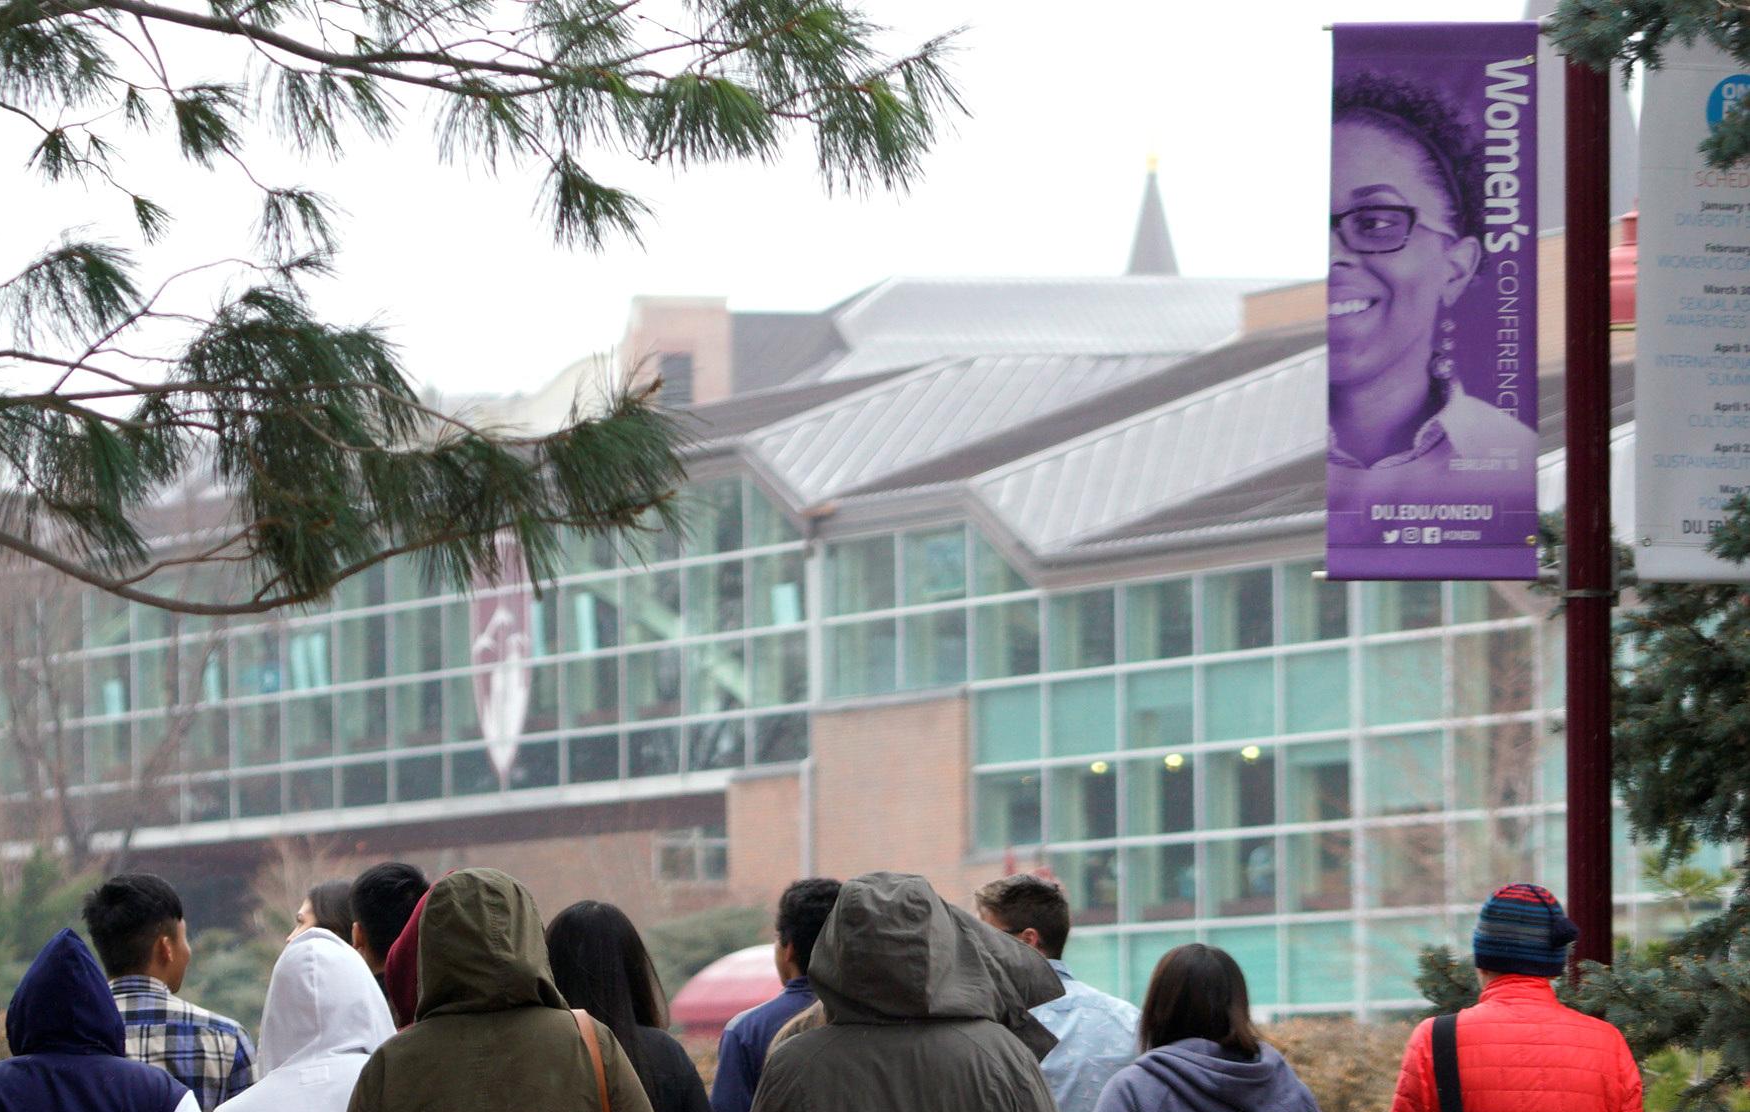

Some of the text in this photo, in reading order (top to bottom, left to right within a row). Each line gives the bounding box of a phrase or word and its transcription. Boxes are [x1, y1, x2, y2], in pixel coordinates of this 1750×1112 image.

[1484, 58, 1530, 253] Women's
[1700, 202, 1744, 214] January
[1704, 285, 1737, 295] March
[1714, 343, 1741, 354] April
[1714, 402, 1740, 413] April
[1714, 443, 1740, 454] April
[1371, 504, 1493, 521] DU.EDU/ONEDU
